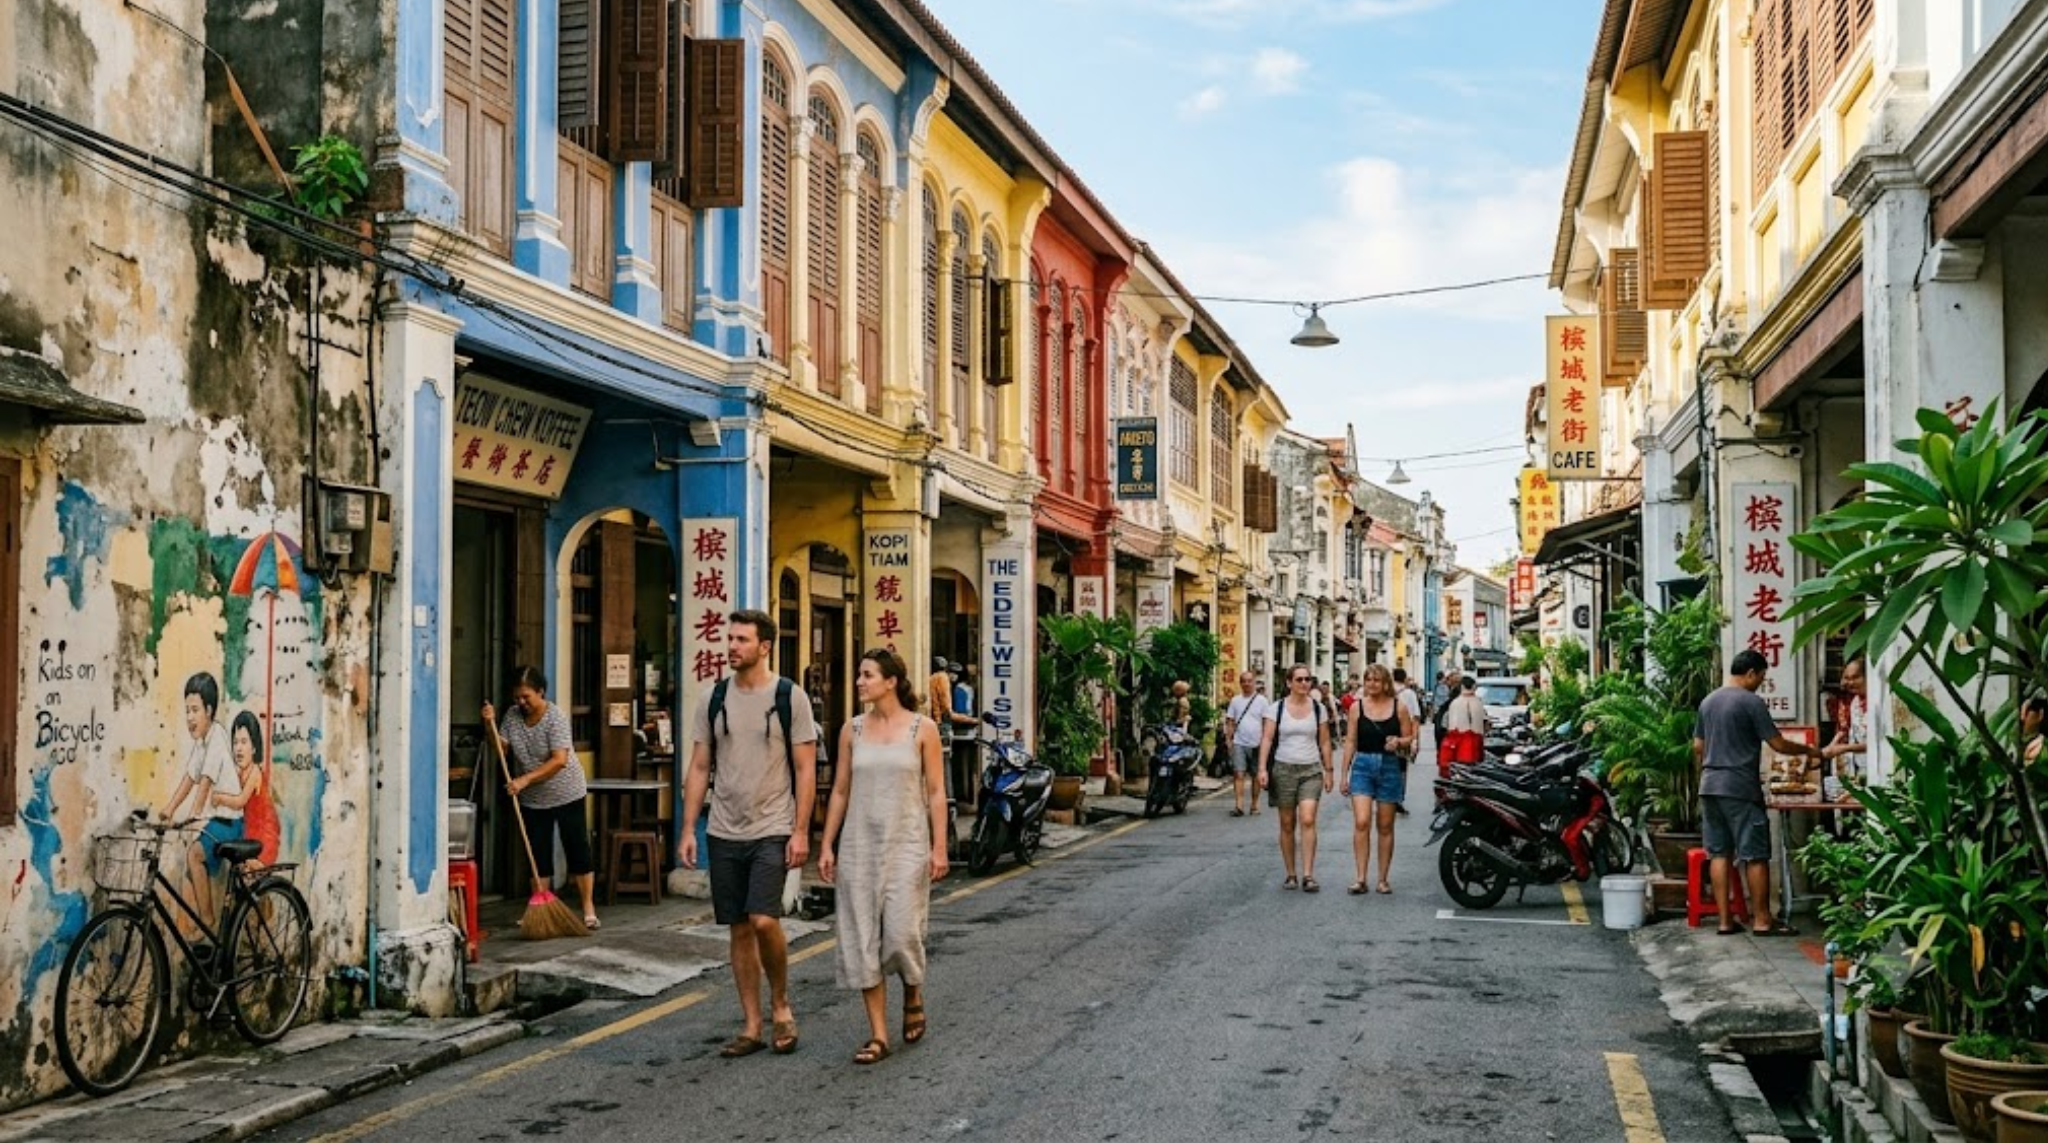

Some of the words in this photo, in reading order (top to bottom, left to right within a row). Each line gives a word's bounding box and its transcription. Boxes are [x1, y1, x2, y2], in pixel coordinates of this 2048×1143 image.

[1552, 451, 1596, 469] CAFE
[869, 534, 908, 549] KOPI
[869, 553, 908, 566] TIAM
[987, 559, 1017, 576] THE
[992, 581, 1013, 730] EDELWEISS
[36, 706, 104, 749] Bicycle
